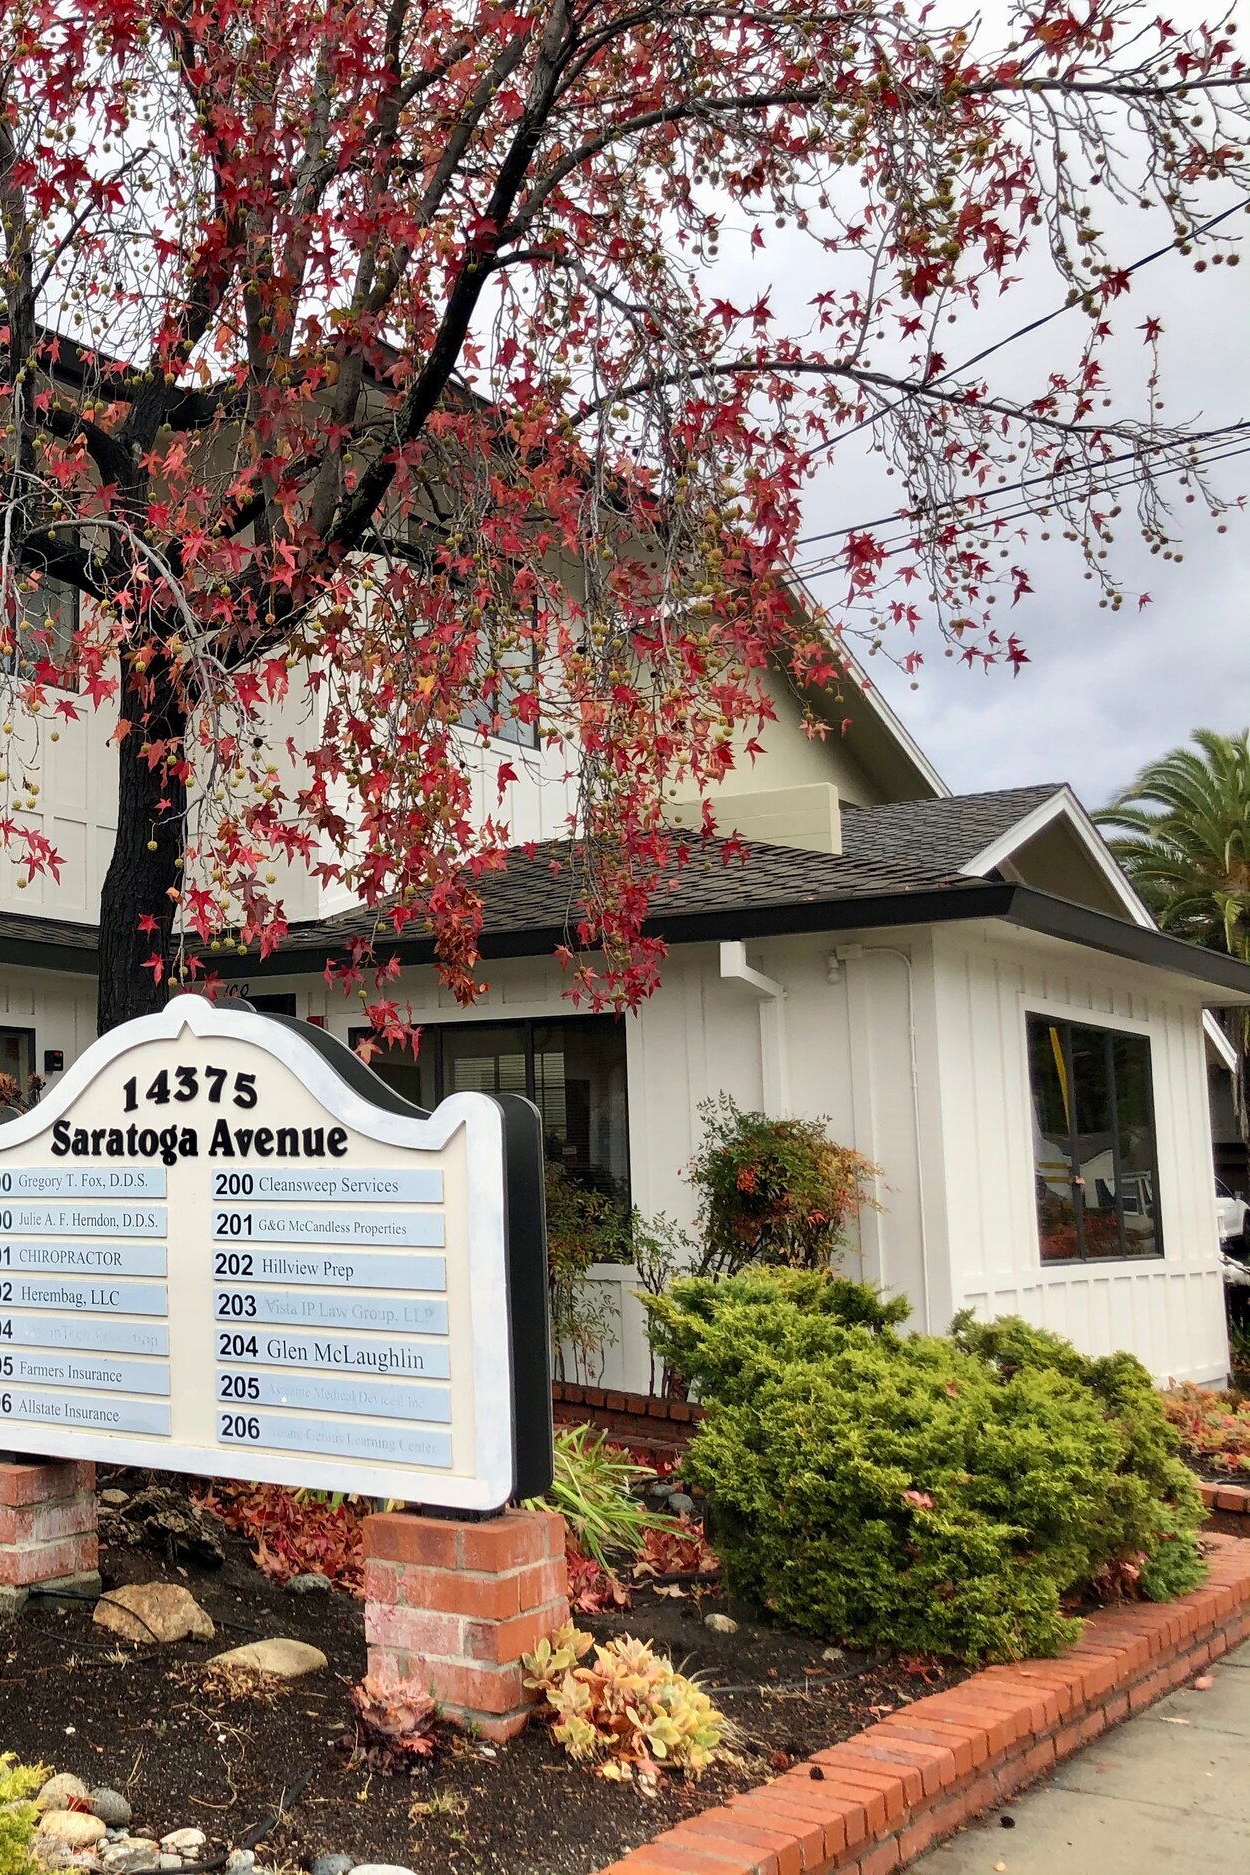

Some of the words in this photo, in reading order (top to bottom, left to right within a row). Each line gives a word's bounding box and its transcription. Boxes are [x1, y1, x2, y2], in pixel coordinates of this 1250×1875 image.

[123, 1065, 258, 1112] 14375
[50, 1120, 198, 1166] Saratoga
[208, 1118, 348, 1158] Avenue
[19, 1174, 62, 1191] Gregory
[66, 1174, 77, 1187] T.
[82, 1174, 106, 1188] Fox,
[110, 1173, 148, 1187] D.D.S.
[216, 1174, 254, 1195] 200
[259, 1177, 336, 1196] Cleansweep
[341, 1178, 398, 1193] Services
[19, 1212, 42, 1226] Julie
[45, 1213, 56, 1226] A.
[60, 1213, 68, 1226] F.
[72, 1213, 120, 1229] Herndon,
[123, 1214, 158, 1228] D.D.S.
[216, 1214, 252, 1236] 201
[258, 1219, 285, 1231] G&G
[289, 1220, 350, 1233] McCandless
[354, 1222, 406, 1236] Properties
[20, 1249, 122, 1266] CHIROPRACTOR
[215, 1253, 254, 1276] 202
[262, 1258, 318, 1275] Hillview
[324, 1262, 354, 1280] Prep
[22, 1286, 86, 1307] Herembag,
[91, 1290, 120, 1306] LLC
[218, 1294, 256, 1316] 203
[266, 1300, 298, 1316] Vista
[302, 1302, 315, 1316] IP
[320, 1303, 347, 1320] Law
[404, 1307, 434, 1323] LLP
[220, 1334, 258, 1357] 204
[268, 1340, 308, 1360] Glen
[314, 1343, 424, 1372] McLaughlin
[20, 1361, 64, 1378] Farmers
[68, 1365, 122, 1382] Insurance
[220, 1375, 260, 1399] 205
[314, 1387, 354, 1401] Medical
[19, 1400, 60, 1416] Allstate
[65, 1404, 120, 1422] Insurance
[222, 1414, 260, 1440] 206
